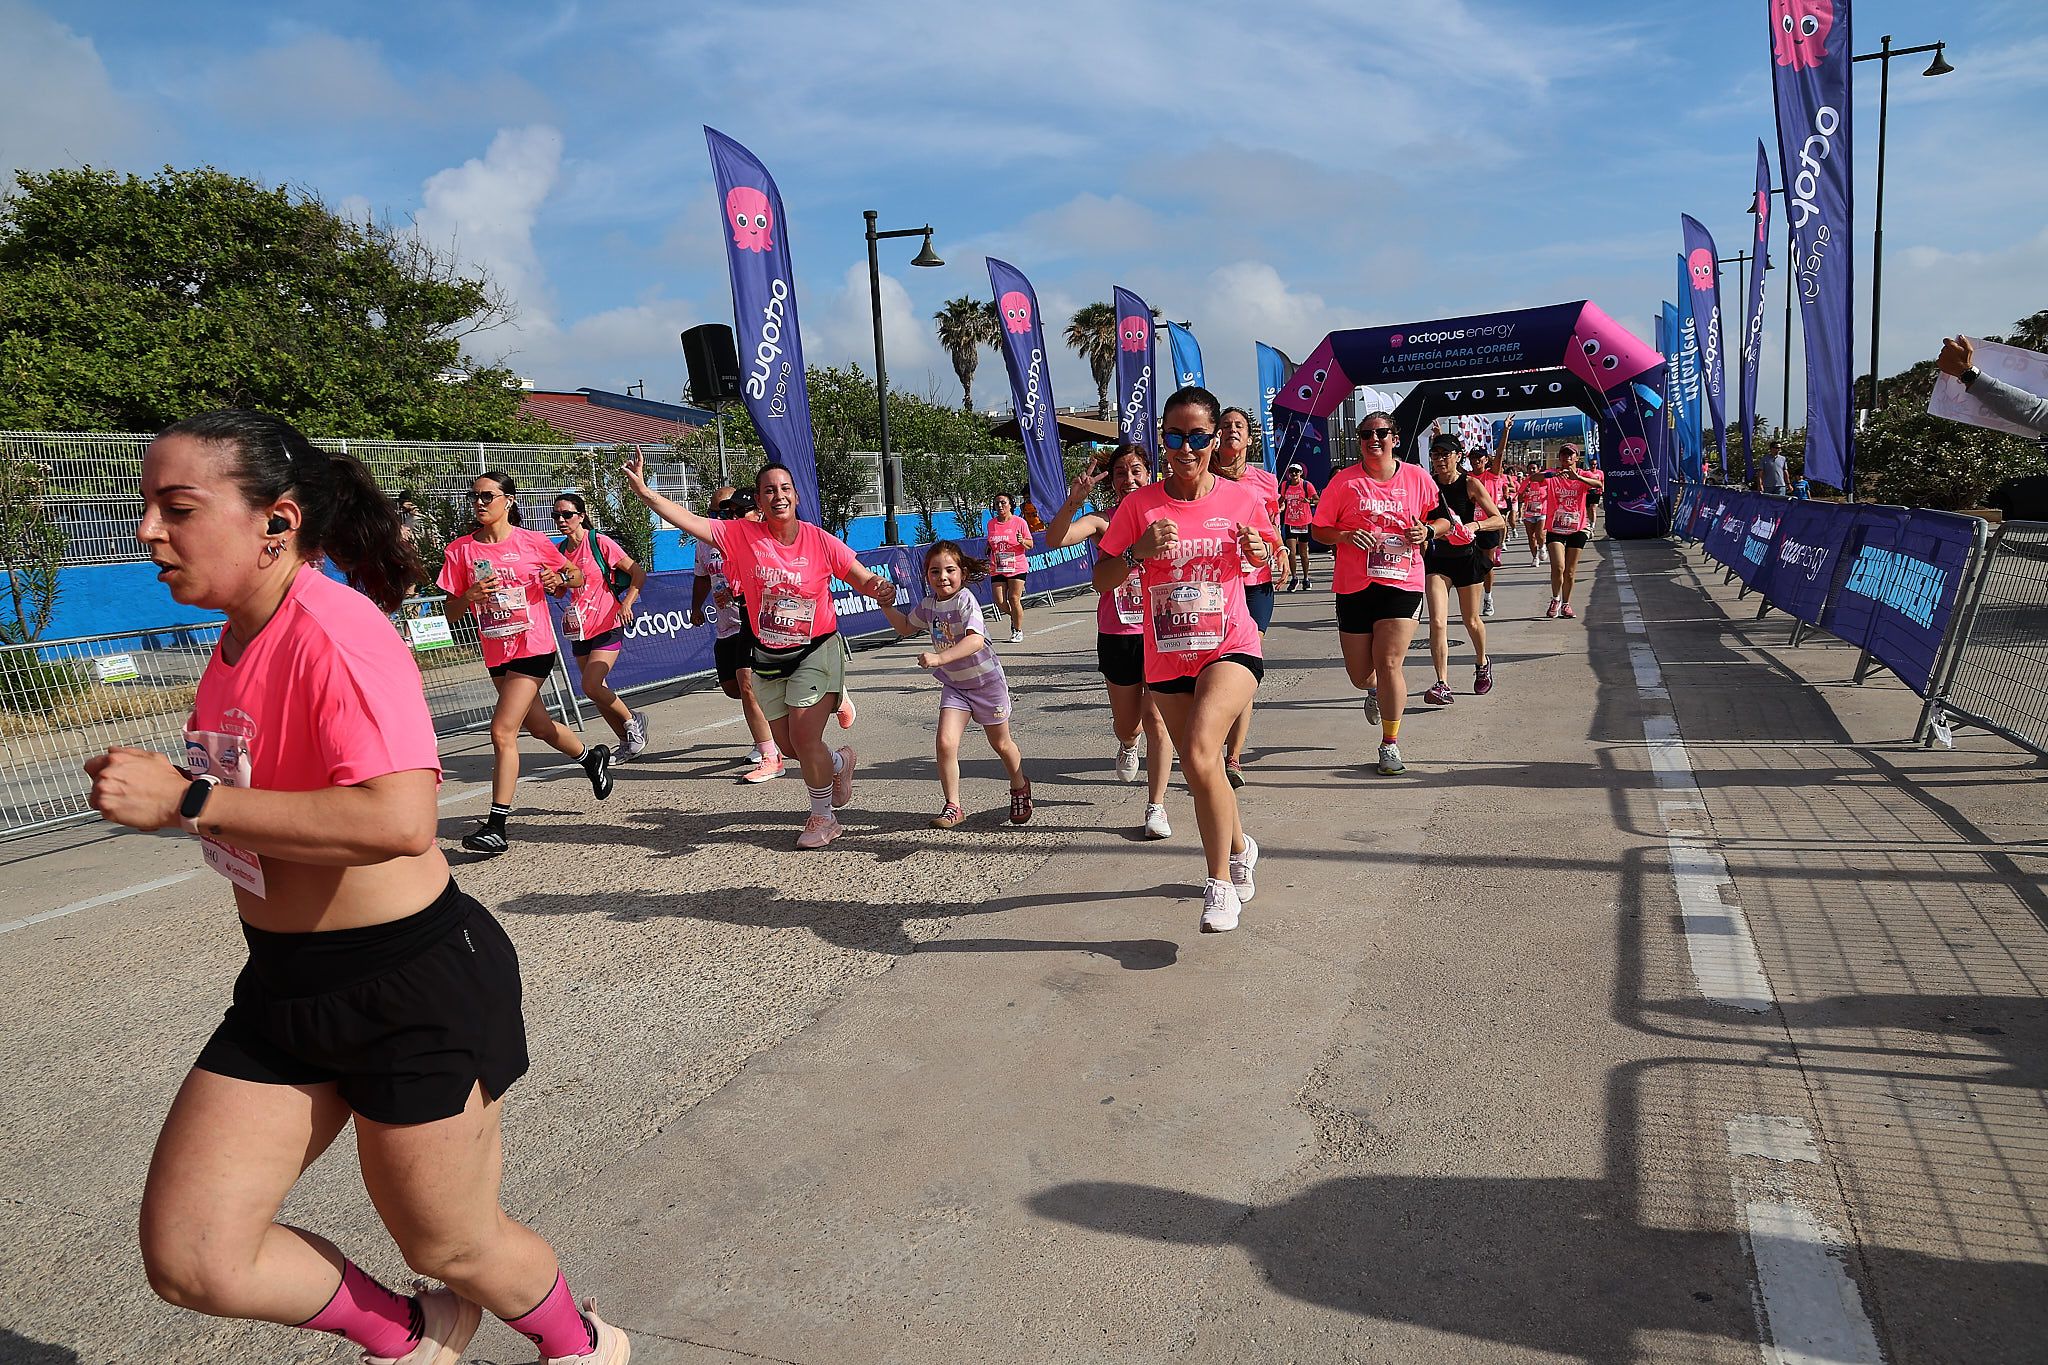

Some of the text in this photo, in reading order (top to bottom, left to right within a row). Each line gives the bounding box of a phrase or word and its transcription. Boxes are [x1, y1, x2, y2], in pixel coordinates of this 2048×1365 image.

[1409, 323, 1516, 344] octopus energy
[1382, 342, 1521, 364] LA ENERGÍA PARA CORRER
[1382, 353, 1524, 374] A LA VELOCIDAD DE LA LUZ
[1445, 382, 1563, 401] VOLVO
[1523, 418, 1564, 436] Marlene
[1359, 499, 1404, 513] CARRERA
[833, 591, 864, 616] cada
[624, 609, 704, 639] octopu
[774, 616, 795, 627] 016
[1172, 612, 1199, 625] 016
